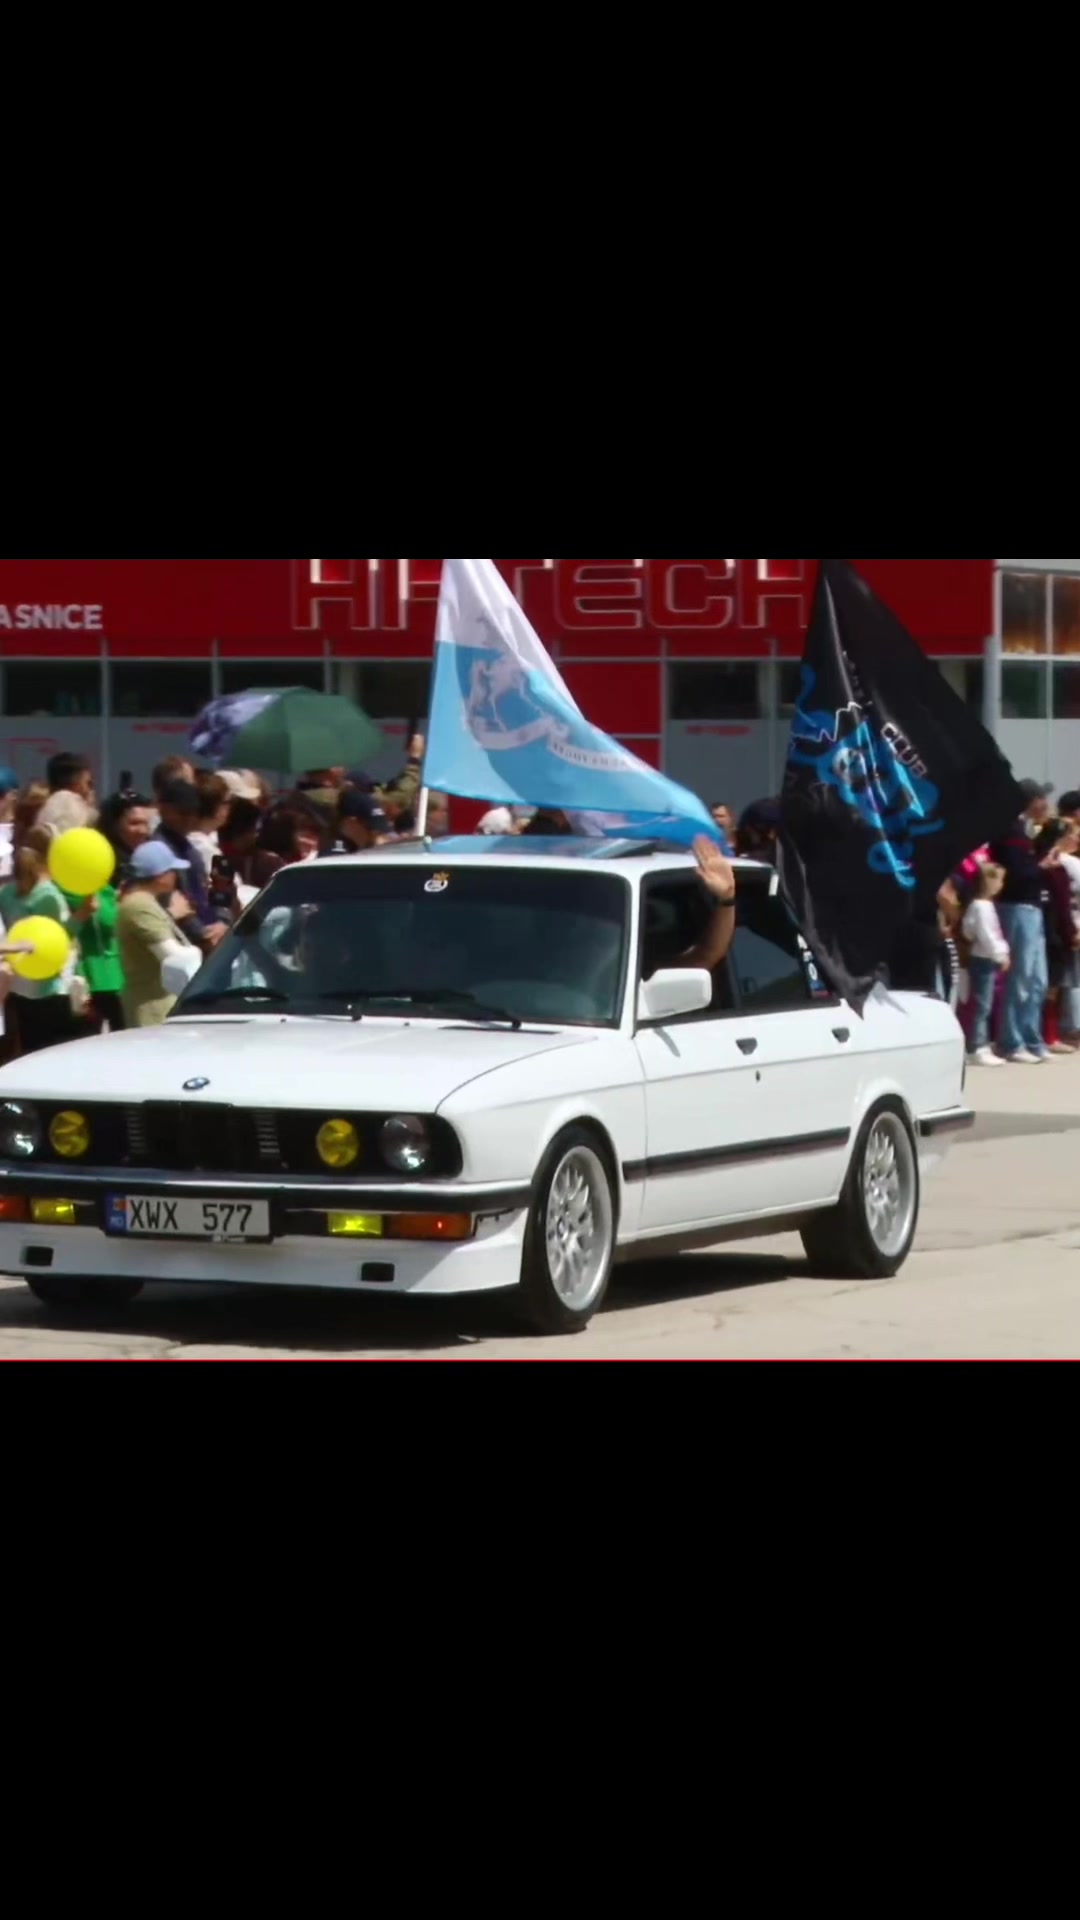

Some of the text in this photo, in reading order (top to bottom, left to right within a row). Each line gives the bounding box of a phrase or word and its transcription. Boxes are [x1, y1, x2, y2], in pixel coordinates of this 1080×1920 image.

[0, 603, 103, 629] ASNICE
[129, 1199, 252, 1232] XWX 577
